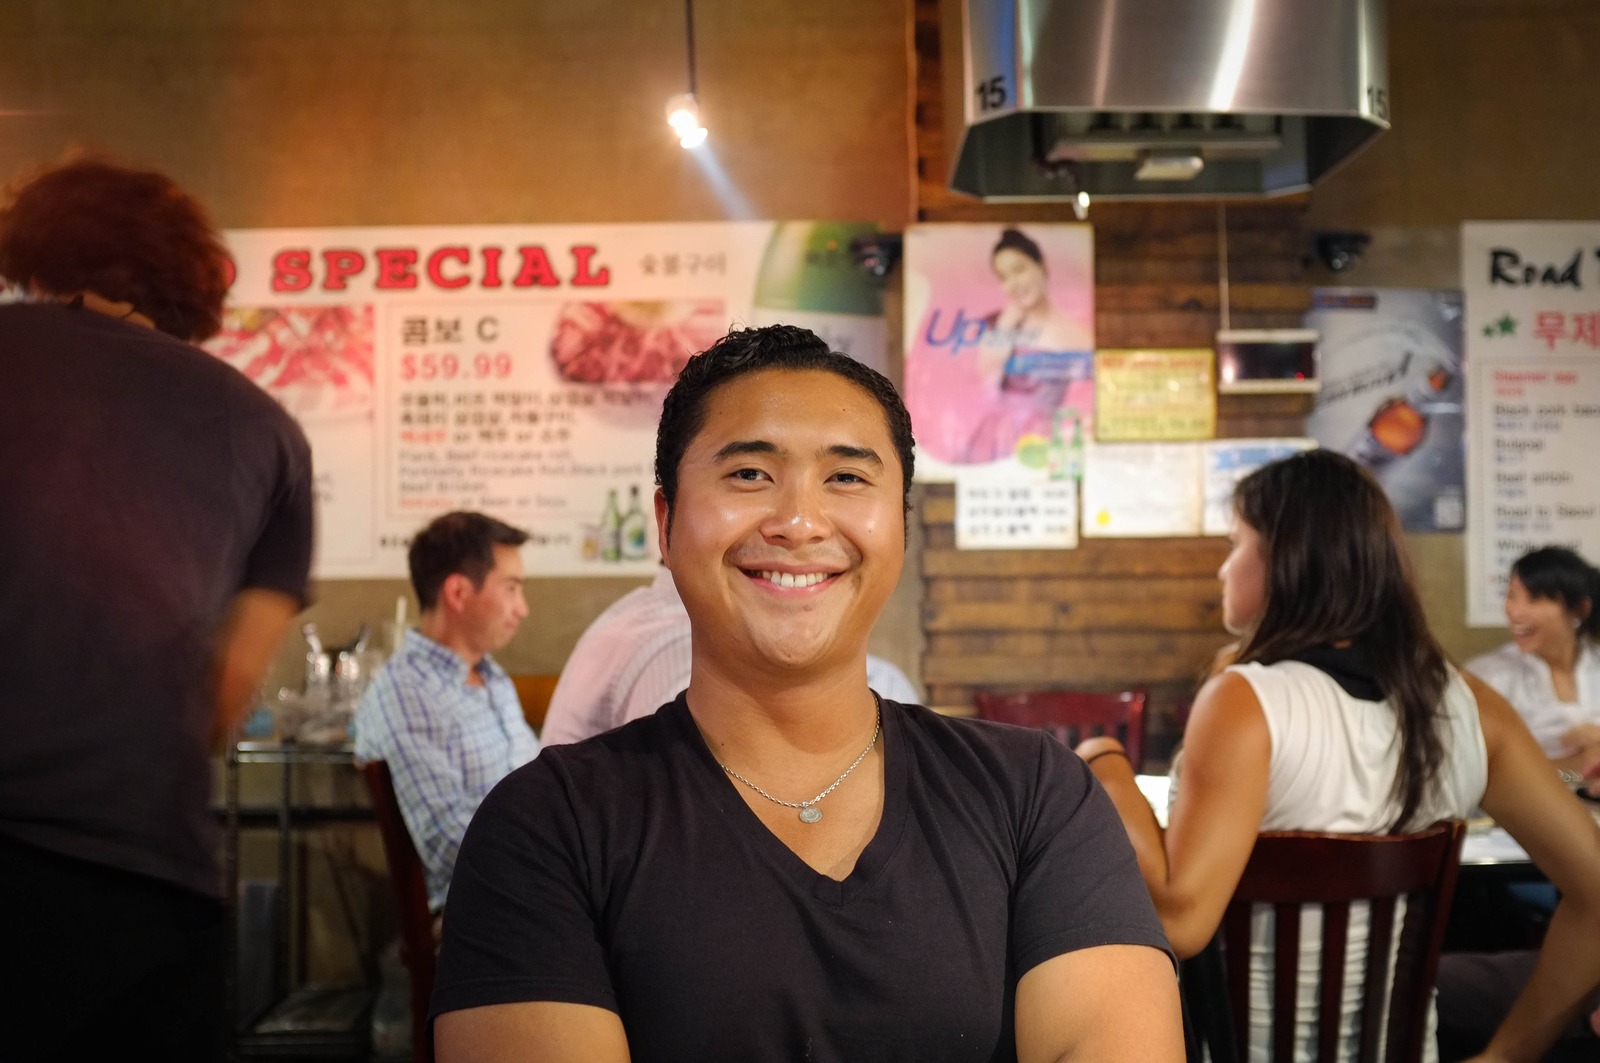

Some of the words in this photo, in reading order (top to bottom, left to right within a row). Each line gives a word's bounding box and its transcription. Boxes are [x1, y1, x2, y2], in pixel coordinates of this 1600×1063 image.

[977, 76, 1006, 110] 15
[1367, 86, 1387, 118] 15
[271, 244, 611, 293] SPECIAL
[1488, 246, 1584, 290] Road
[476, 315, 500, 343] C
[401, 352, 513, 381] $59.99
